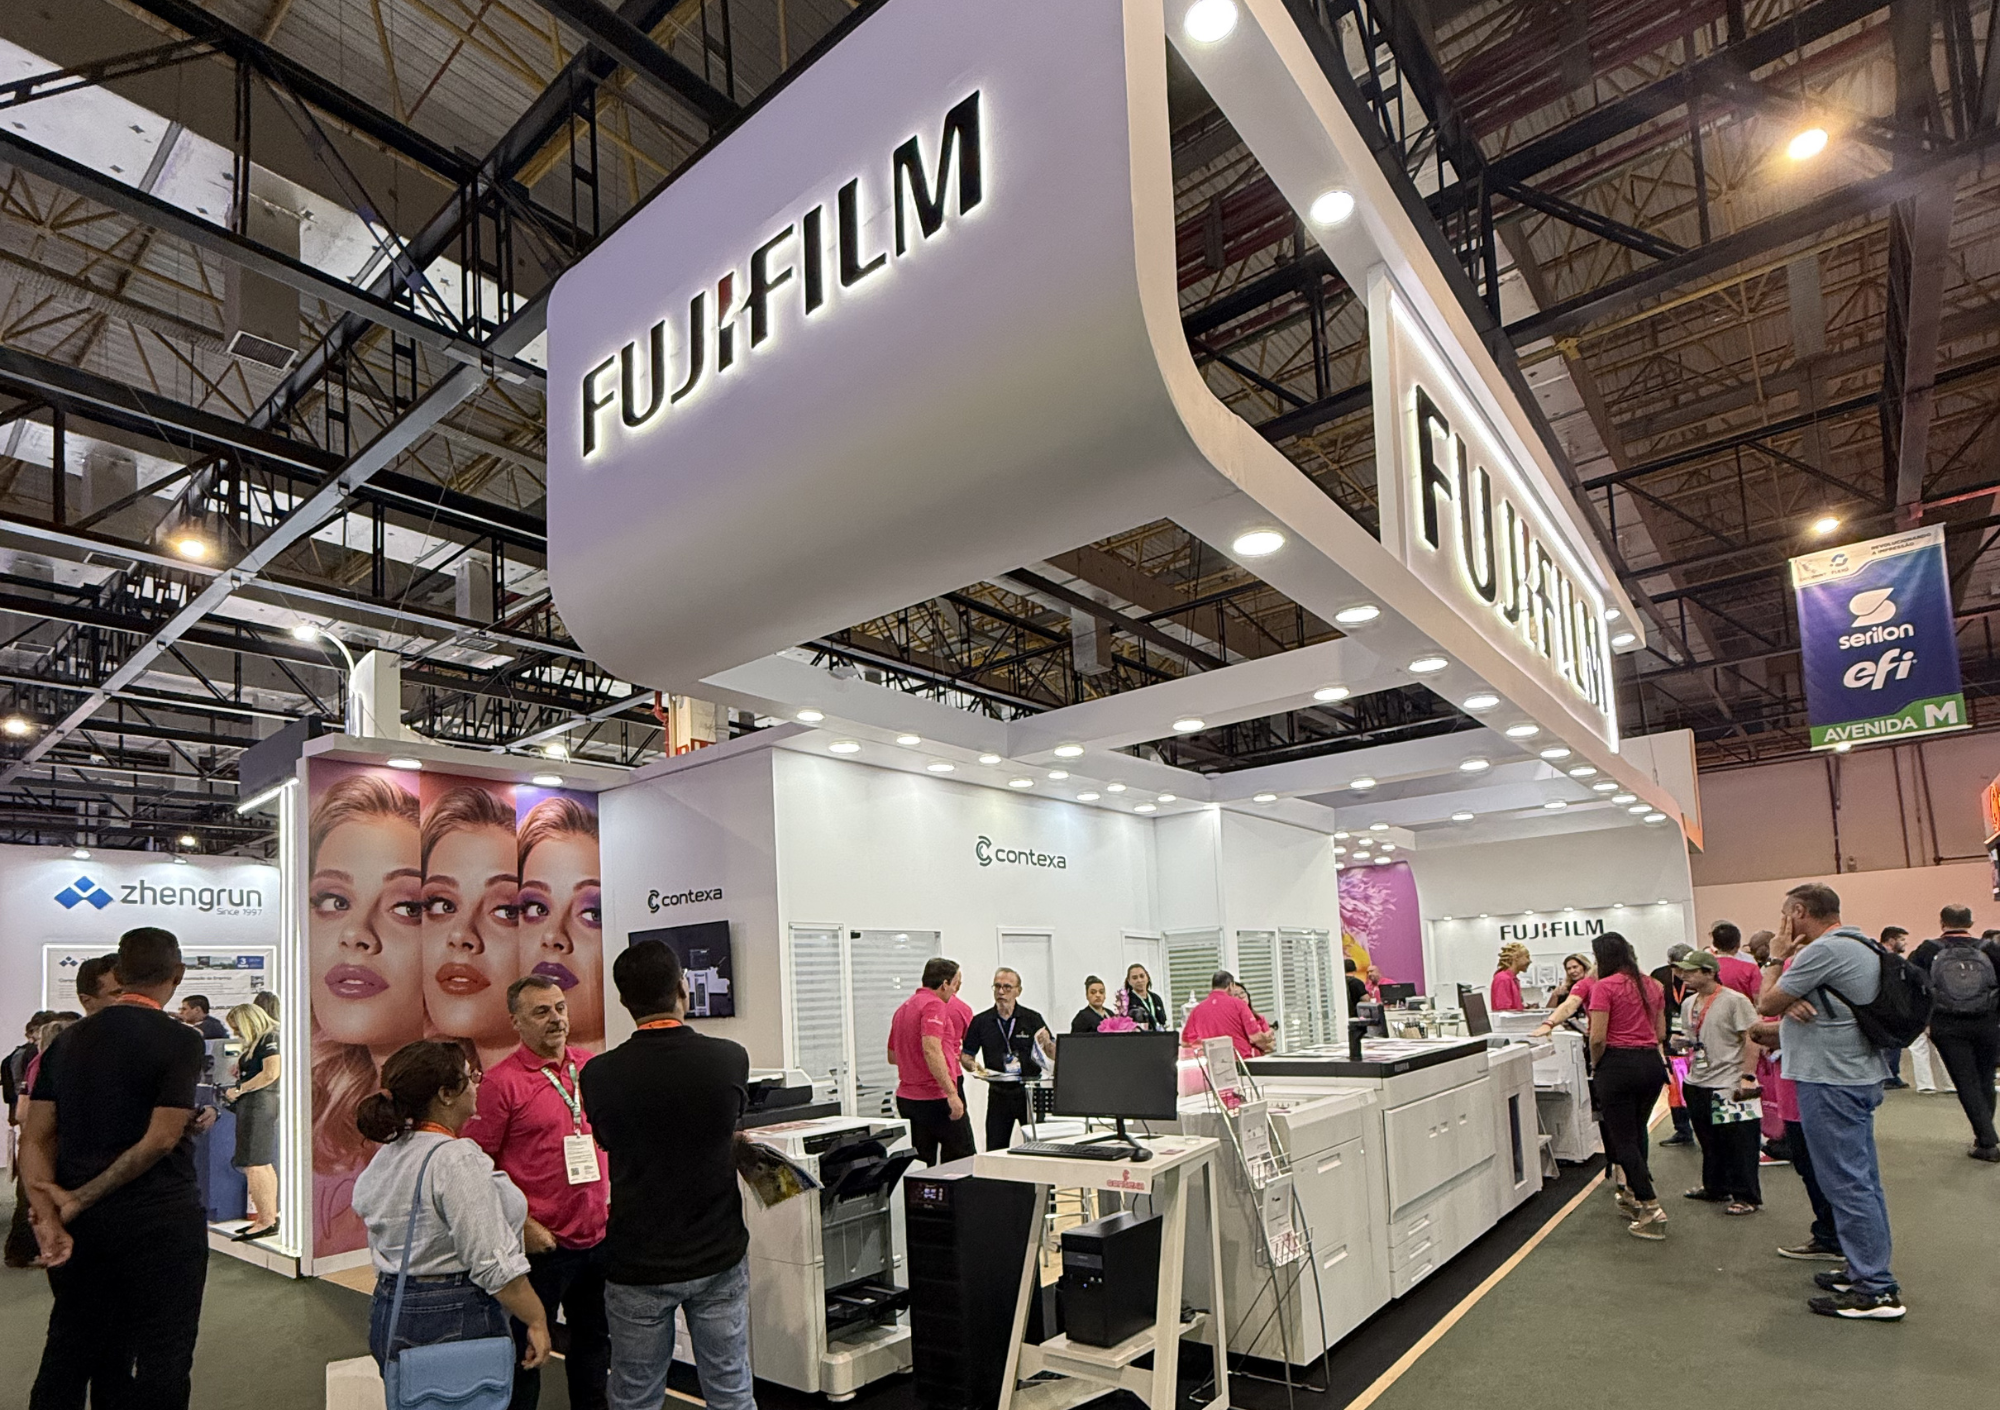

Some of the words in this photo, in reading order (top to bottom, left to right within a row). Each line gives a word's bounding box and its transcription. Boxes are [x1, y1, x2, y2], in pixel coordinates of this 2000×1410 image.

[583, 89, 982, 458] FUJIFILM
[1415, 383, 1610, 716] FUJIFILM
[1838, 623, 1914, 650] serilon
[1843, 648, 1915, 691] efi
[1824, 716, 1918, 742] AVENIDA
[1924, 701, 1959, 728] M
[995, 848, 1067, 869] contexa
[120, 879, 262, 912] zhengrun
[661, 888, 723, 907] contexa
[216, 907, 239, 916] Since
[243, 908, 262, 916] 1997
[1500, 919, 1604, 941] FUJIFILM
